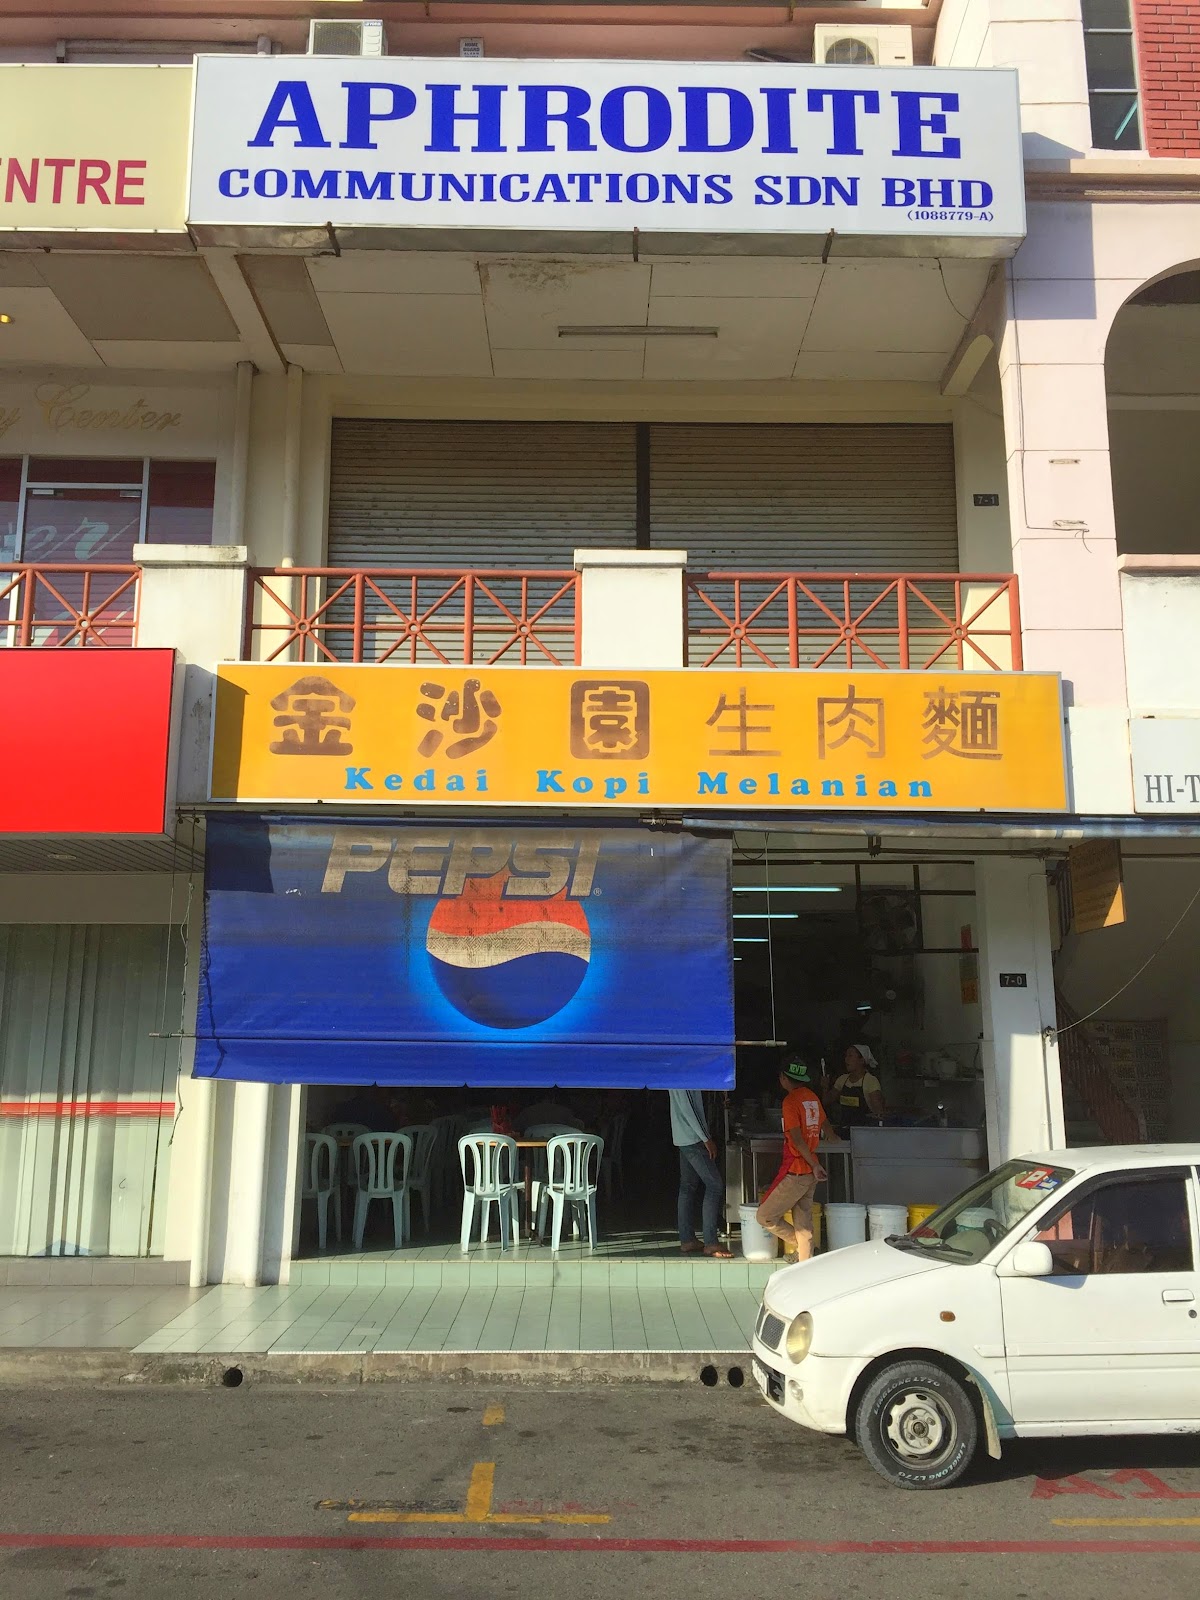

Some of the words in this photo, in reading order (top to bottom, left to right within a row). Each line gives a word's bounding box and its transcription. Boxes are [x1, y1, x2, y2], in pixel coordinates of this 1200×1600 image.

[247, 80, 961, 159] APHRODITE
[0, 158, 147, 205] NTRE
[218, 169, 733, 204] COMMUNICATIONS
[754, 175, 859, 206] SDN
[882, 178, 993, 208] BHD
[907, 210, 994, 222] (1088779-A)
[345, 767, 489, 792] Kedai
[536, 770, 650, 799] Kopi
[697, 771, 933, 798] Melanian
[321, 828, 600, 897] PEPSI
[1004, 975, 1023, 985] 7-0
[874, 1377, 912, 1415] LINGLONG
[928, 1442, 966, 1480] LINGLONG
